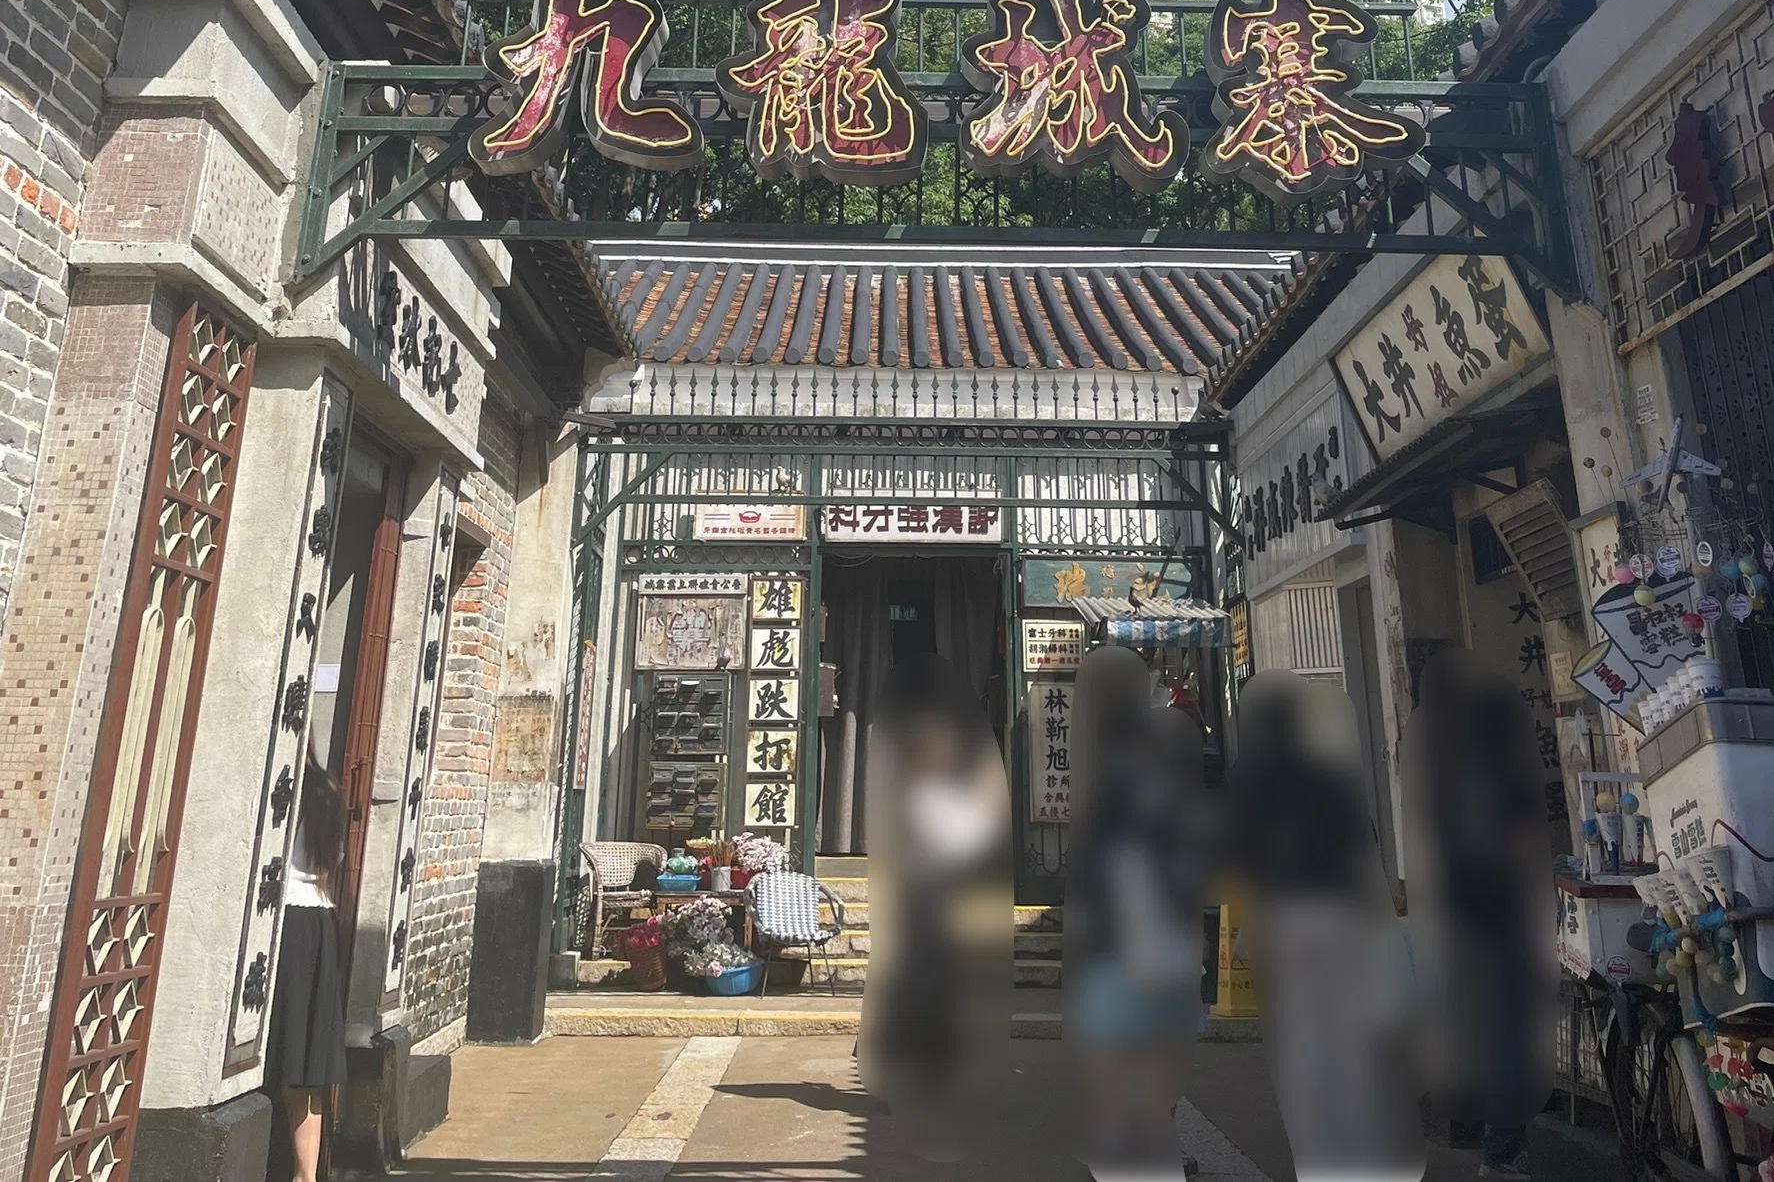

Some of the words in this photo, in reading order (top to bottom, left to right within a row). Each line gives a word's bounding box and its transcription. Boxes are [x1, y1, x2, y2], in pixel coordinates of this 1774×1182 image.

[1028, 628, 1067, 639] 富士牙科
[751, 580, 797, 826] 雄彪跌打館
